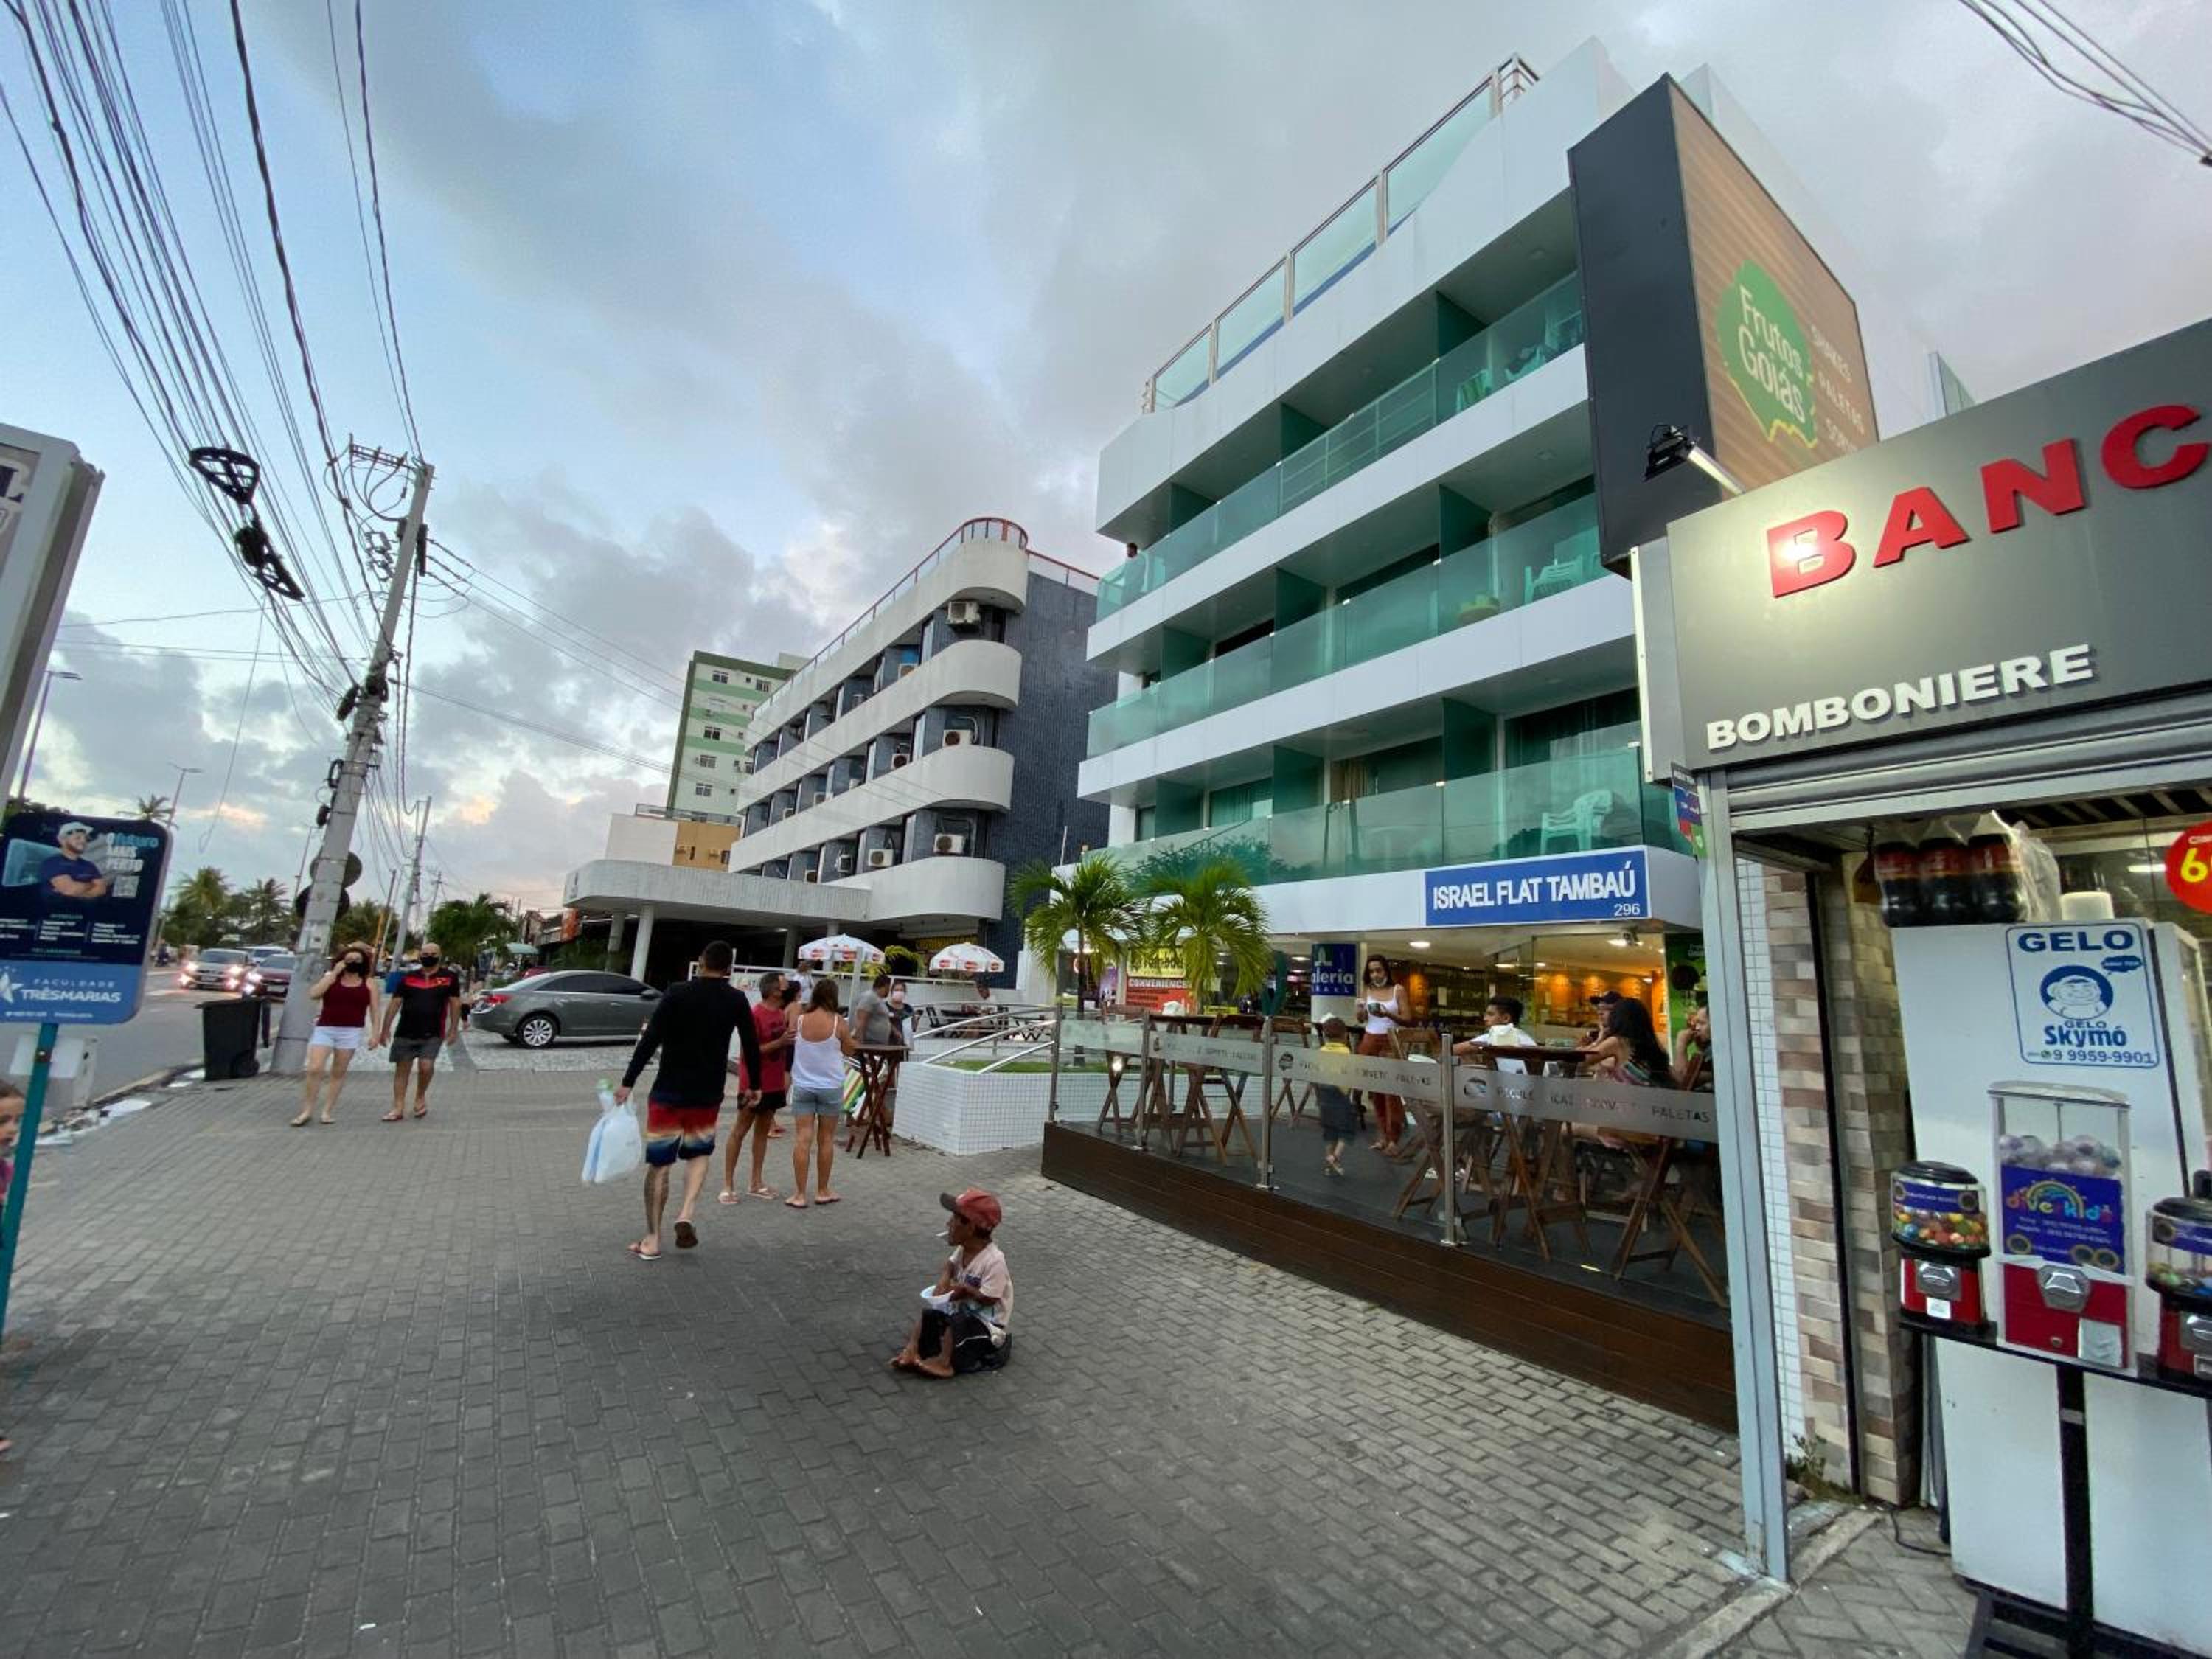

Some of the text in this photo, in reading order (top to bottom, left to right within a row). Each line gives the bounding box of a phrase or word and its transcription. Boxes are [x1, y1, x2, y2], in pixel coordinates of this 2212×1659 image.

[1738, 324, 1806, 424] Goiás
[1767, 404, 2211, 599] BANC
[1706, 644, 2096, 751] BOMBONIERE
[1433, 860, 1636, 911] ISRAEL FLAT TAMBAÚ
[1613, 903, 1641, 917] 296
[2018, 930, 2134, 953] GELO
[21, 986, 122, 1003] TRÊSMARIAS
[34, 978, 115, 988] FACULDADE
[2064, 1020, 2107, 1029] GELO
[2044, 1025, 2127, 1048] Skymó
[2052, 1049, 2154, 1064] 9 9959-9901
